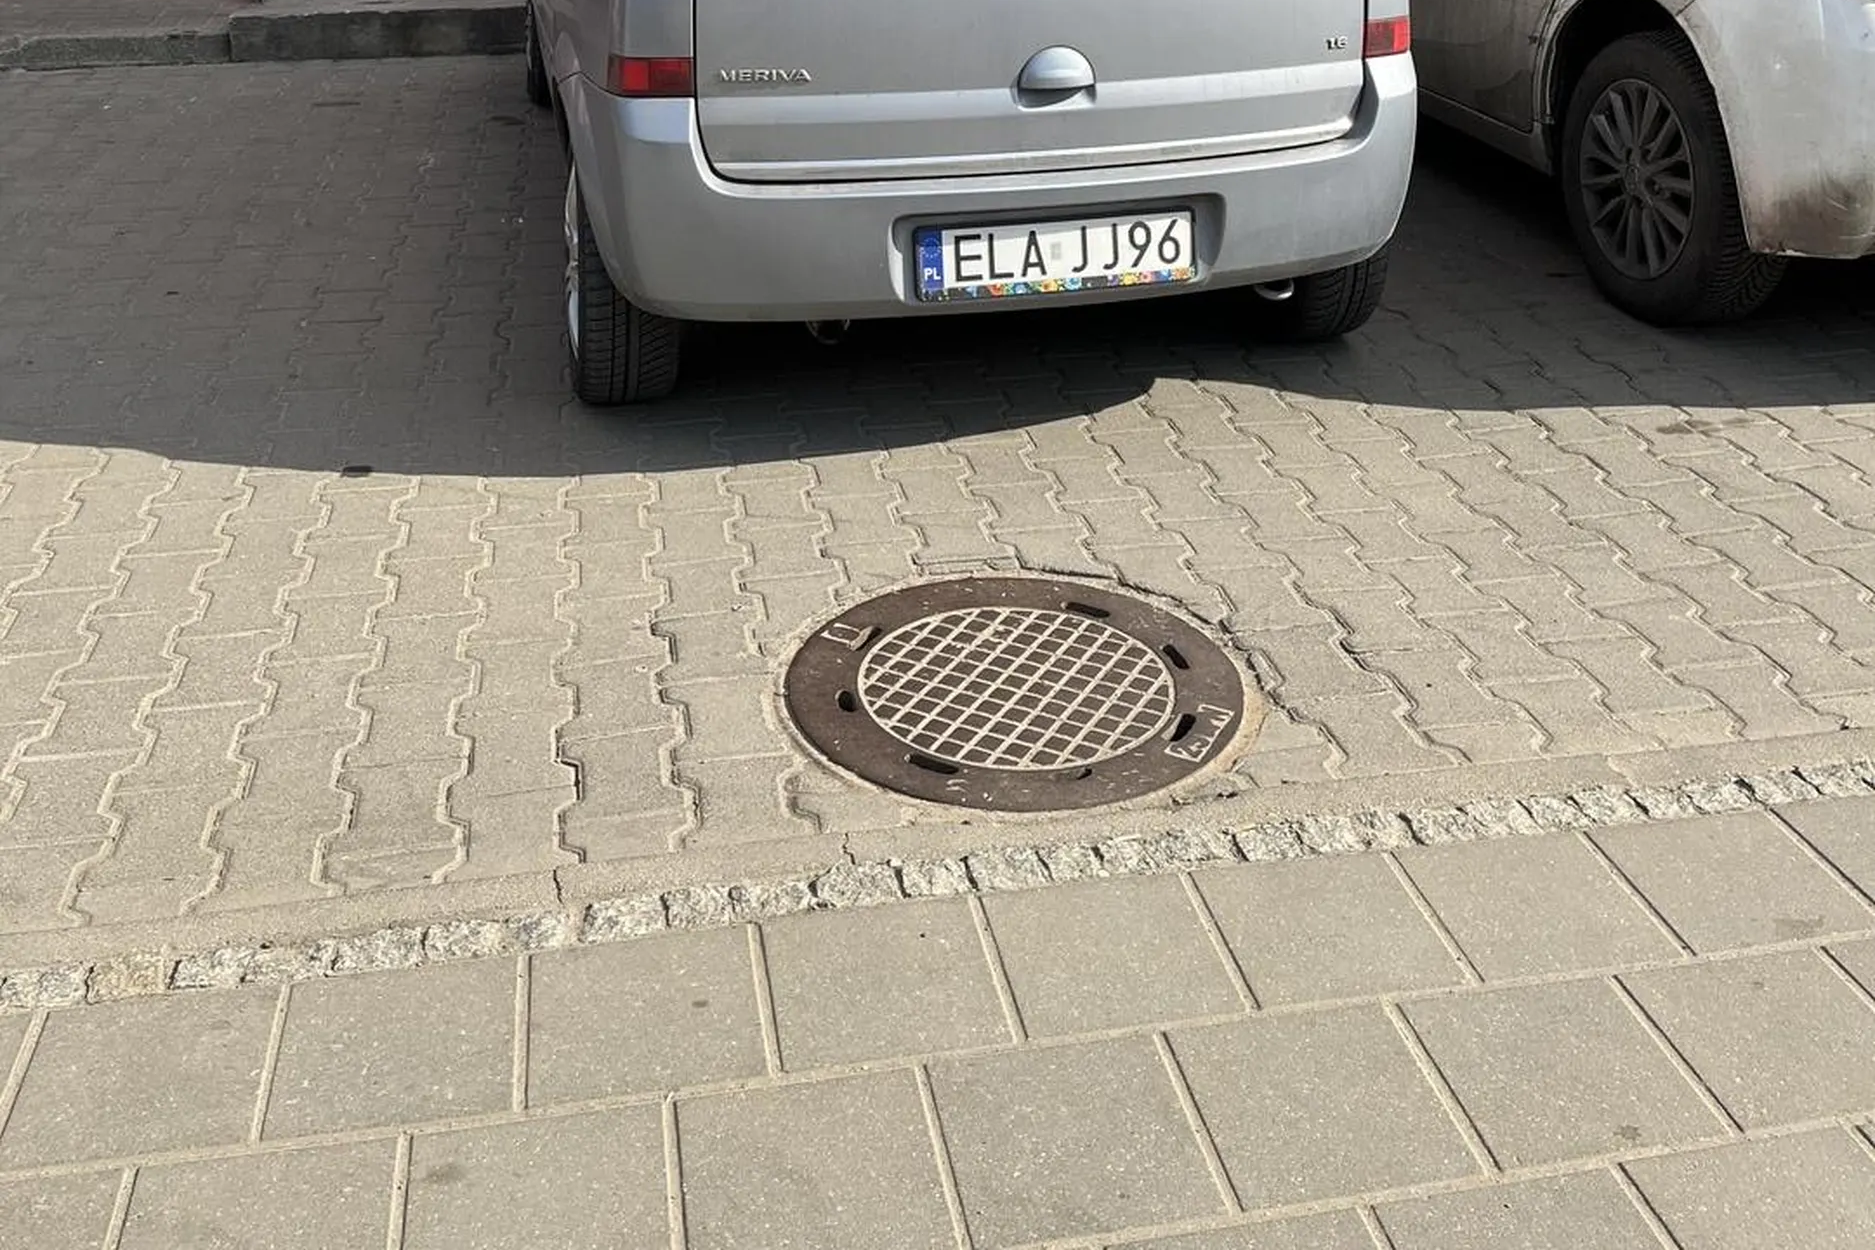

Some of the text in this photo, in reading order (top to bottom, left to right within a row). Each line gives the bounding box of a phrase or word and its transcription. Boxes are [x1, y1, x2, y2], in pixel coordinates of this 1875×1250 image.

[719, 68, 812, 83] MERIVA
[953, 218, 1181, 282] ELA JJ96
[924, 267, 941, 281] PL
